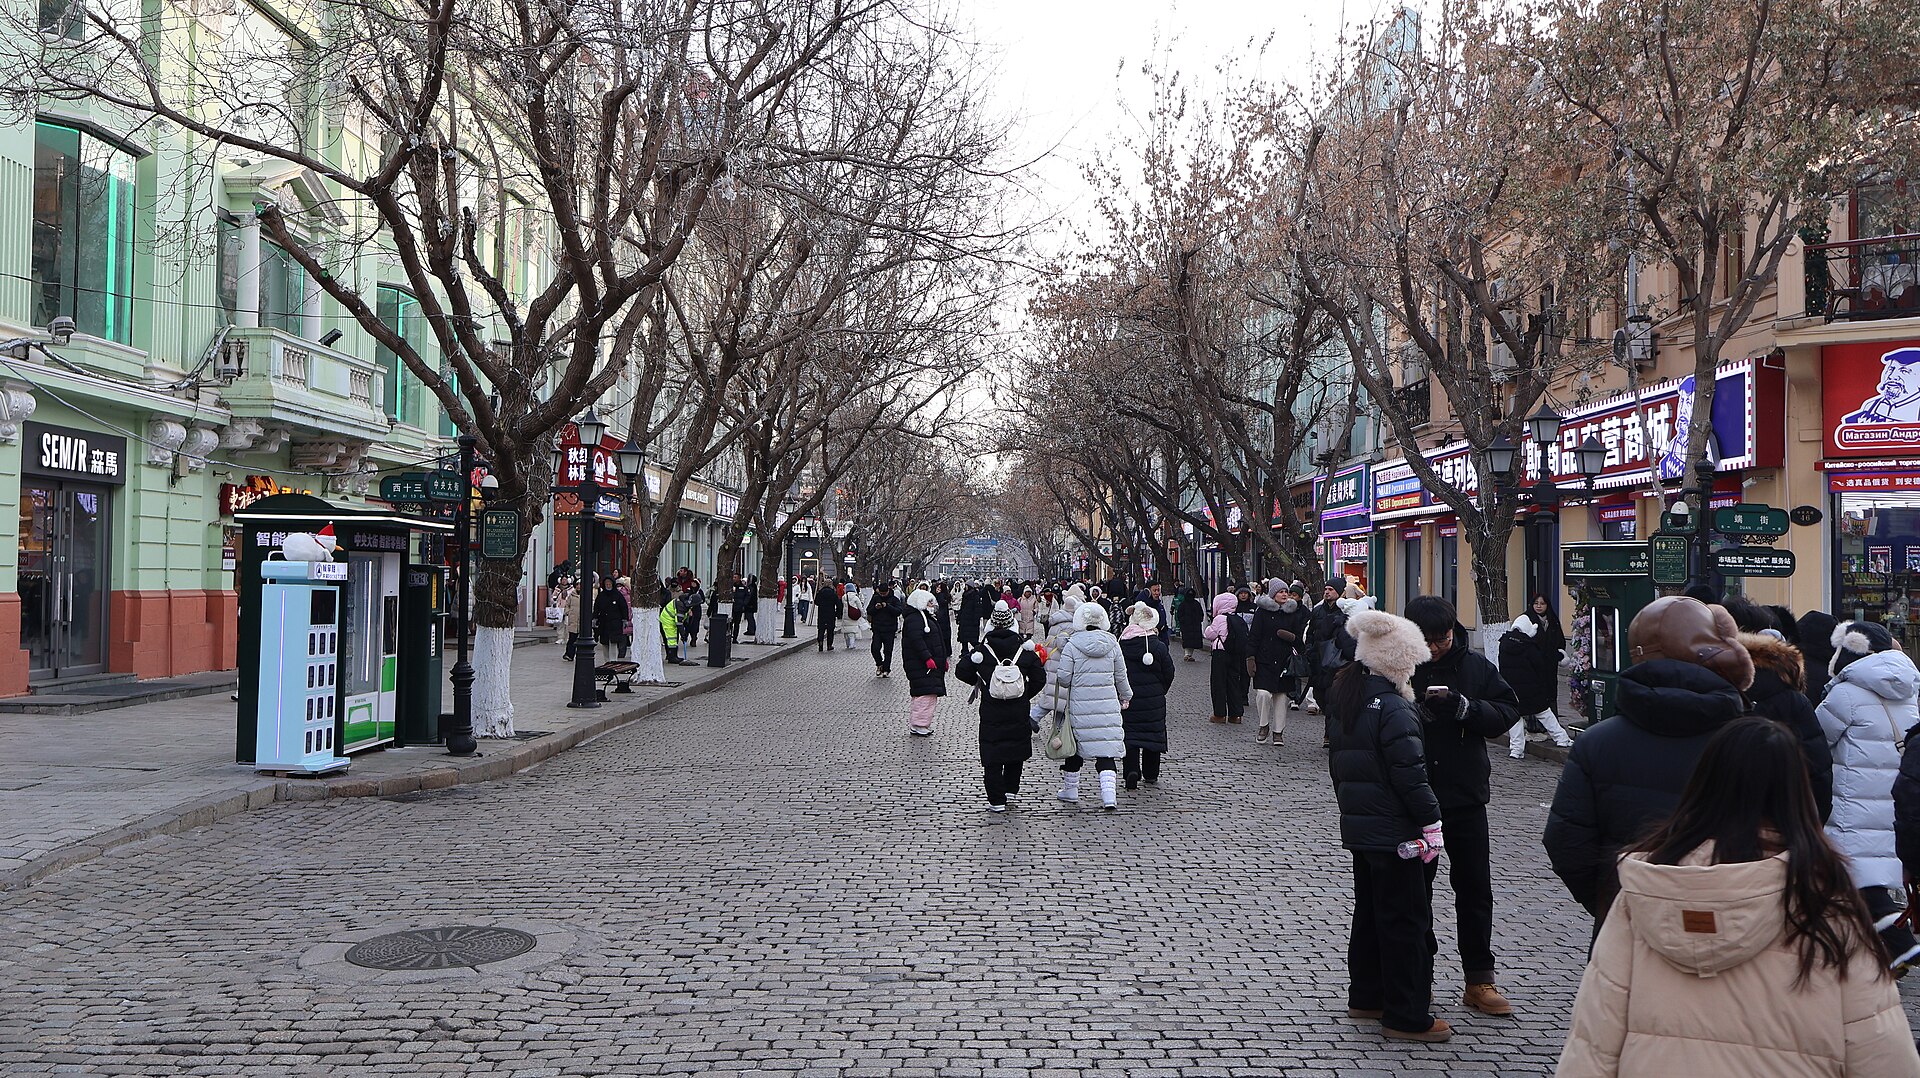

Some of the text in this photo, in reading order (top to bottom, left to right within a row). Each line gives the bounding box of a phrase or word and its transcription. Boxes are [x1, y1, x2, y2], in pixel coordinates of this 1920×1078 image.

[1845, 430, 1888, 440] Магазин
[433, 479, 460, 492] 中央大街
[1718, 556, 1744, 564] 市场监管
[1771, 557, 1791, 565] 服务站
